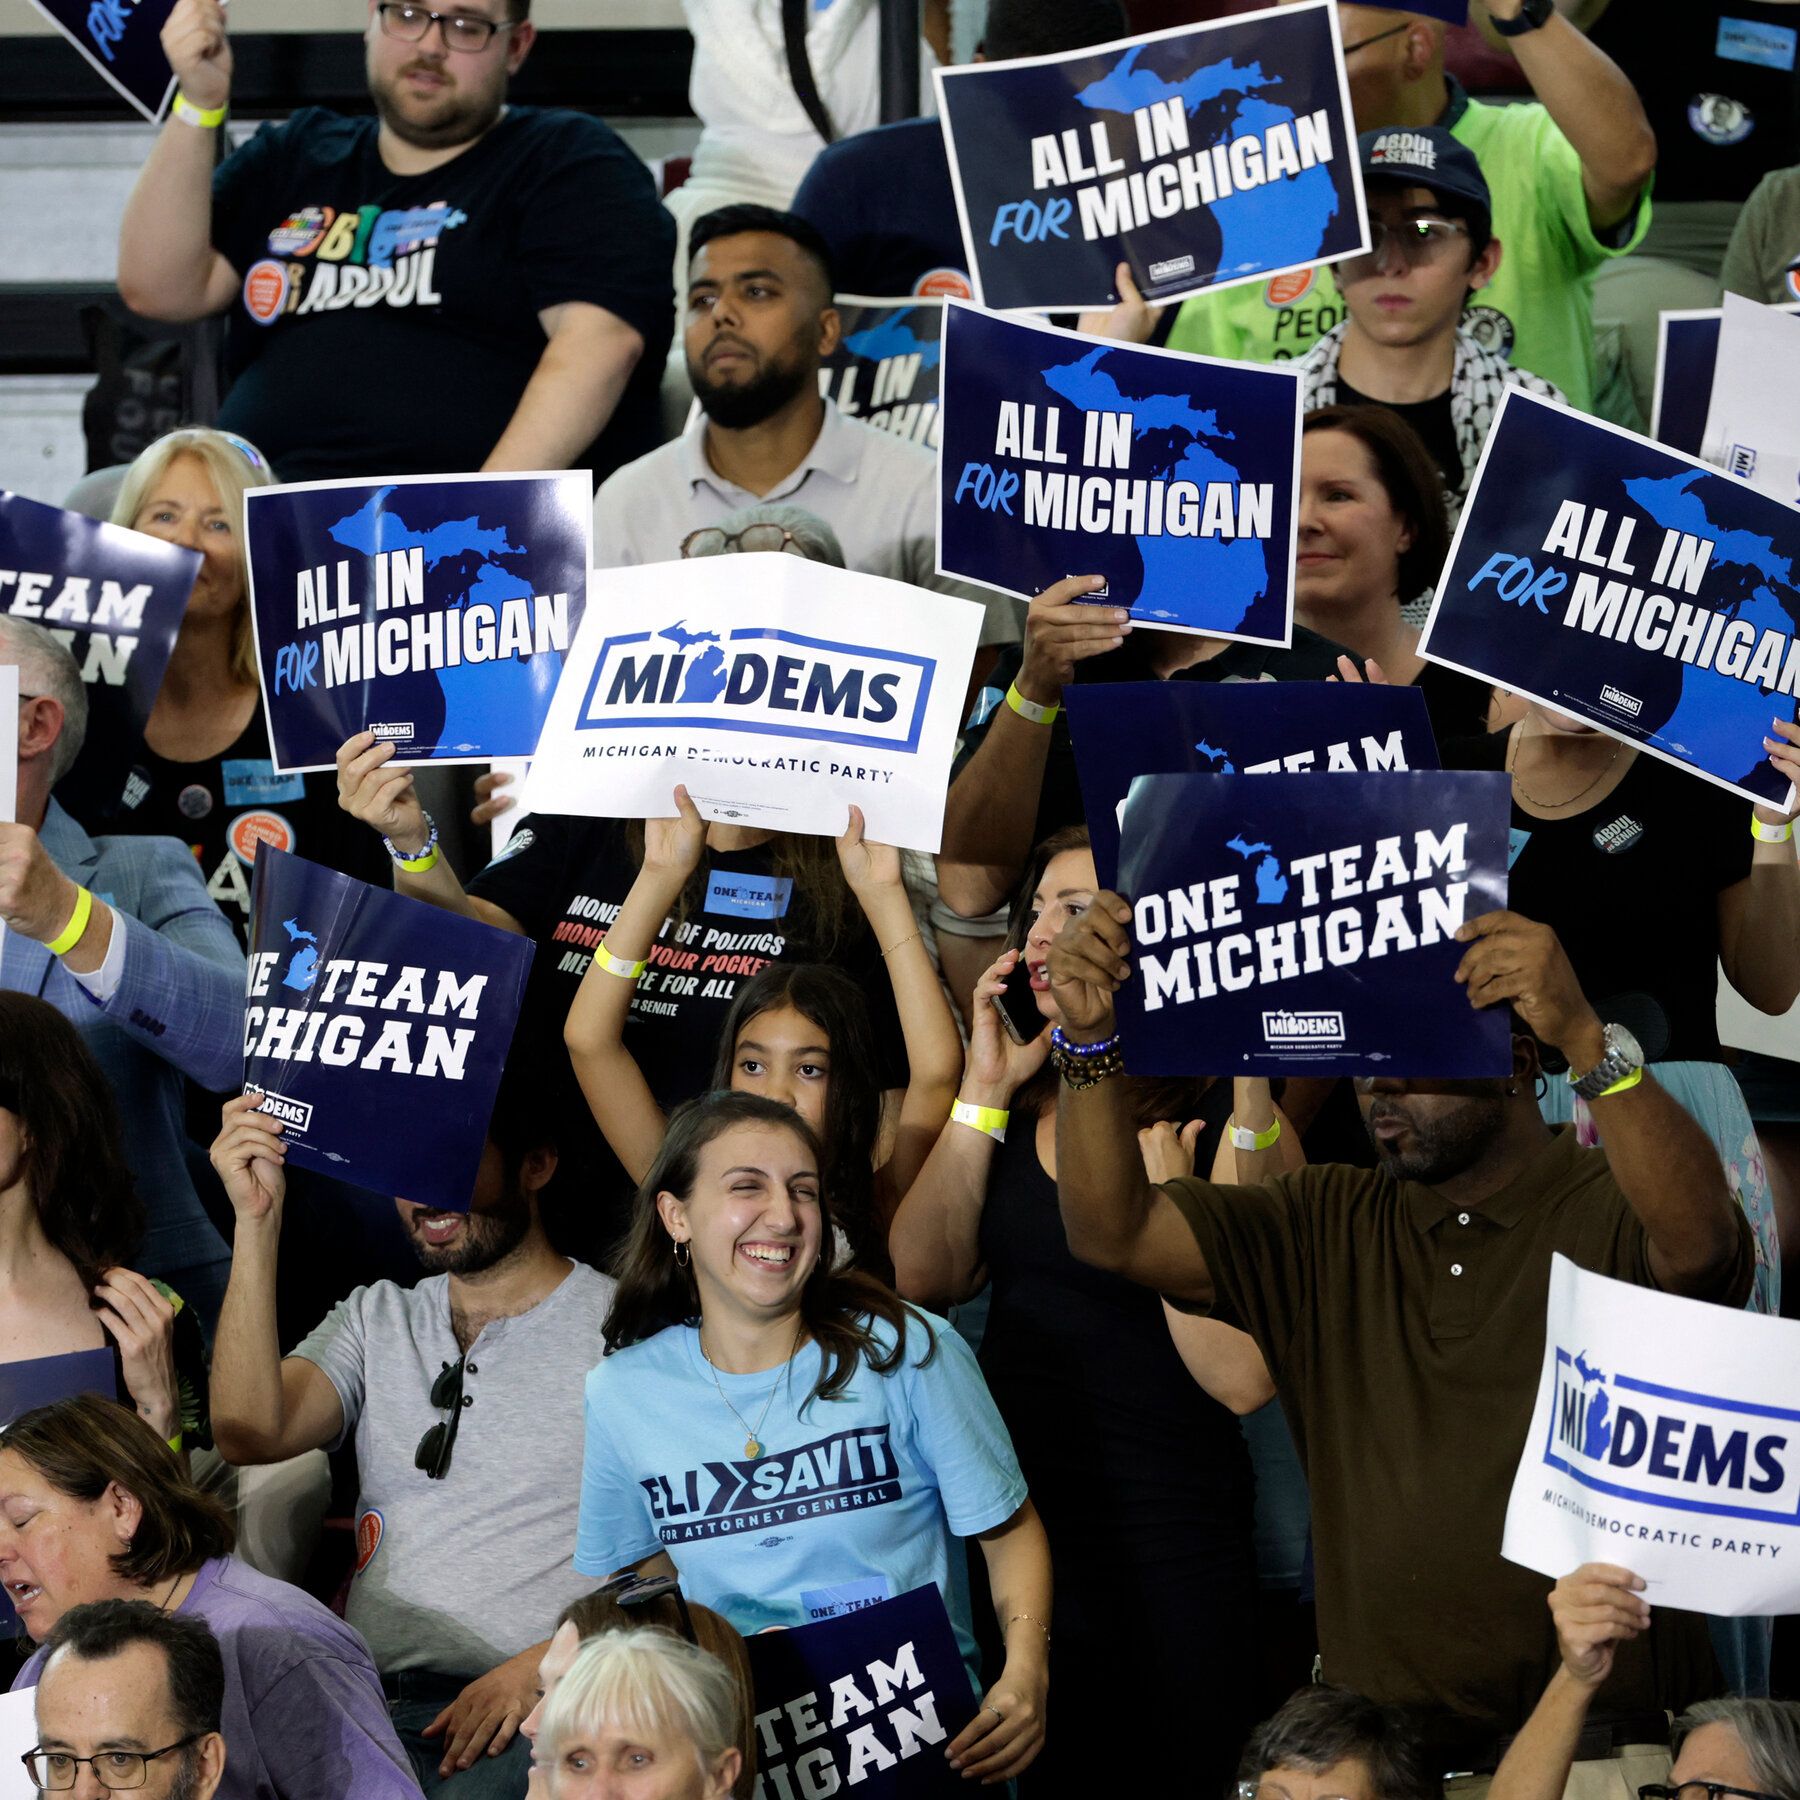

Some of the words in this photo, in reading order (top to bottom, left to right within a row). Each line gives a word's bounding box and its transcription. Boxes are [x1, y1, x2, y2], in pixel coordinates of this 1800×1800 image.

[1031, 121, 1126, 190] ALL
[1134, 95, 1190, 163] IN
[989, 198, 1073, 247] FOR
[1077, 109, 1334, 241] MICHIGAN
[870, 352, 922, 408] IN
[995, 400, 1067, 464] ALL
[1083, 410, 1134, 469] IN
[955, 462, 1019, 516] FOR
[1024, 469, 1274, 539] MICHIGAN
[1541, 499, 1636, 576] ALL
[1650, 528, 1714, 596] IN
[297, 560, 360, 630] ALL
[375, 547, 424, 611] IN
[1467, 552, 1567, 614] FOR
[274, 640, 318, 696] FOR
[322, 593, 569, 689] MICHIGAN
[583, 745, 677, 758] MICHIGAN
[830, 762, 893, 784] PARTY
[1595, 814, 1636, 846] ABDUL
[1611, 822, 1643, 847] SENATE
[713, 886, 738, 897] ONE
[1134, 874, 1242, 945] ONE
[1290, 822, 1468, 907] TEAM
[552, 921, 607, 949] MONE
[648, 944, 697, 971] YOUR
[566, 895, 621, 924] MONE
[674, 921, 702, 946] OF
[702, 928, 785, 956] POLITICS
[1139, 881, 1468, 1011] MICHIGAN
[319, 960, 488, 1020] TEAM
[640, 999, 679, 1017] SENATE
[660, 974, 699, 996] FOR
[701, 979, 735, 999] ALL
[243, 1006, 476, 1080] CHIGAN
[639, 1469, 700, 1519] ELI
[751, 1432, 888, 1500] SAVIT
[661, 1528, 678, 1541] FOR
[685, 1509, 785, 1538] ATTORNEY
[797, 1489, 887, 1516] GENERAL
[1712, 1538, 1782, 1558] PARTY
[811, 1605, 836, 1618] ONE
[754, 1641, 926, 1758] TEAM
